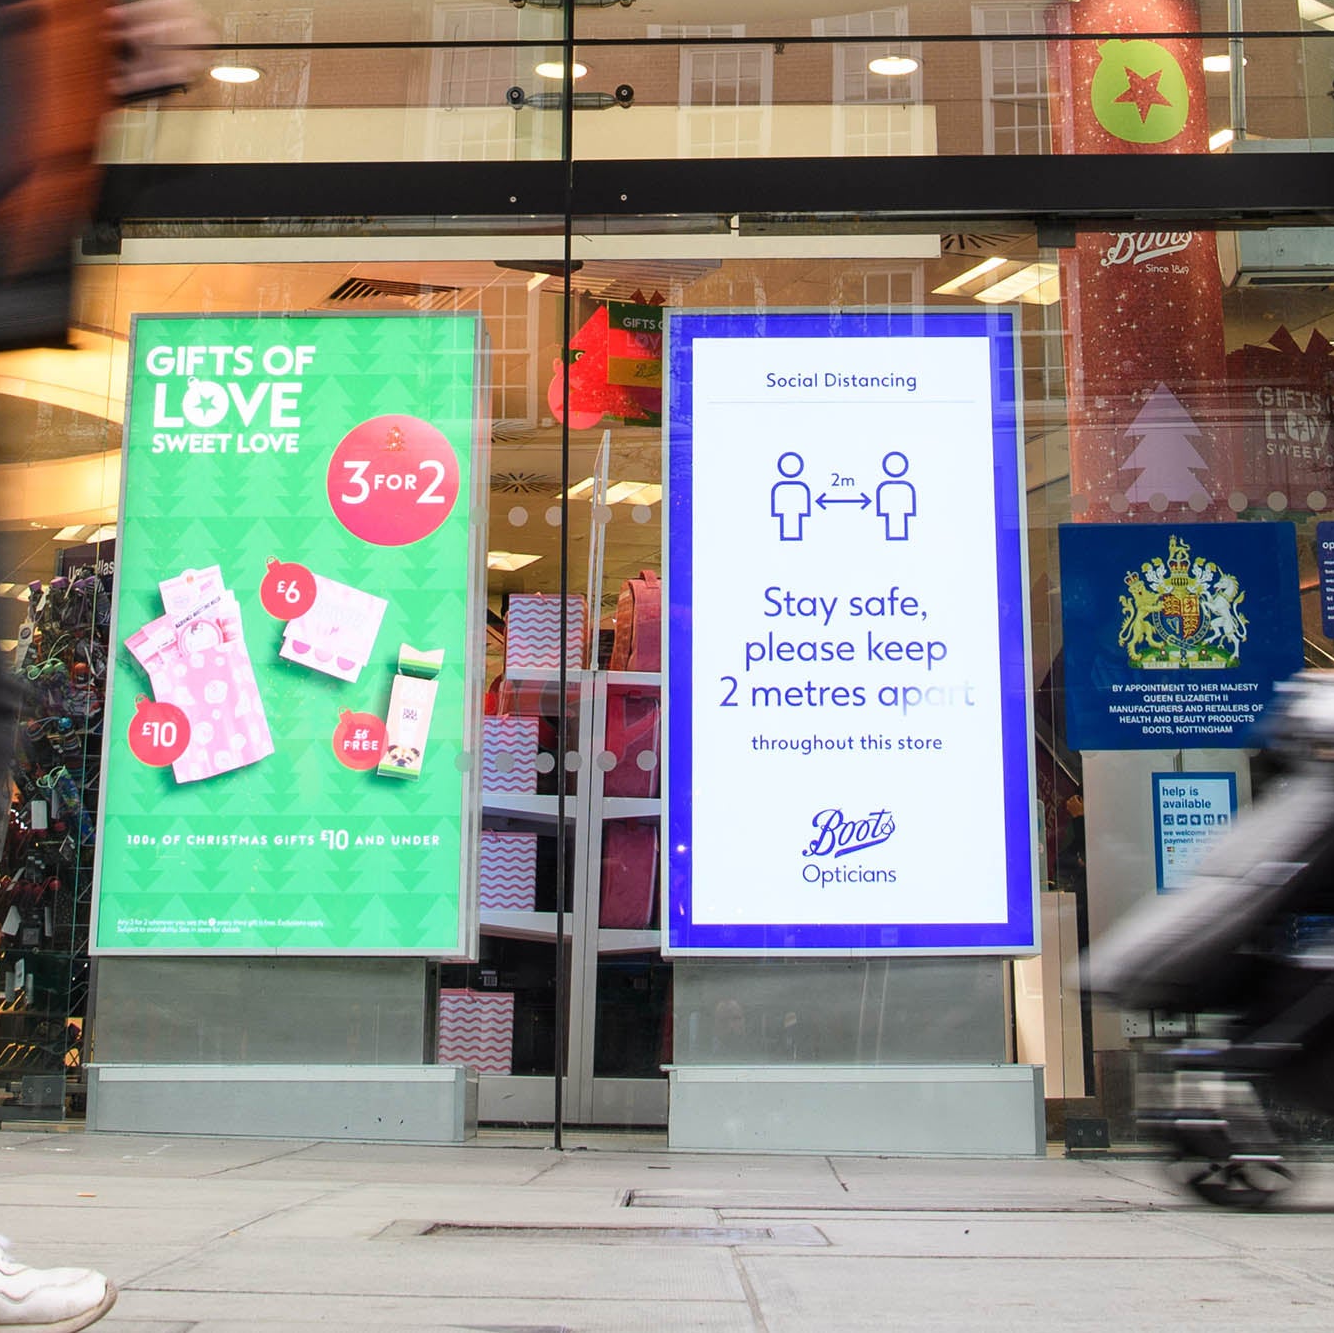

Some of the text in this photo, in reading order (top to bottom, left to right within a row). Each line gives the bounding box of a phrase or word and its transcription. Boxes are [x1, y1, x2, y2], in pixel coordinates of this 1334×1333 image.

[1145, 264, 1189, 275] Since 1849
[623, 317, 653, 329] GIFTS
[627, 332, 661, 349] LOV
[146, 346, 316, 376] GIFTS OF
[766, 372, 917, 392] Social Distancing
[152, 376, 303, 428] LOVE
[1256, 386, 1321, 414] GIFTS
[152, 434, 299, 454] SWEET LOVE
[341, 460, 445, 505] 3 FOR 2
[831, 473, 855, 487] 2m
[277, 580, 301, 603] £6
[764, 586, 928, 626] Stay safe,
[745, 631, 948, 671] please keep
[719, 676, 739, 707] 2
[752, 681, 866, 707] metres
[1112, 684, 1123, 692] BY
[1125, 684, 1185, 692] APPOINTMENT
[1175, 694, 1221, 702] ELIZABETH
[1109, 705, 1183, 713] MANUFACTURERS
[1205, 704, 1249, 712] RETAILERS
[1154, 715, 1172, 723] AND
[1173, 715, 1207, 723] BEAUTY
[1208, 715, 1255, 723] PRODUCTS
[142, 722, 177, 747] £10
[1142, 725, 1233, 734] BOOTS, NOTTINGHAM
[344, 740, 379, 750] FREE
[752, 735, 943, 755] throughout this store
[1163, 787, 1198, 797] help is
[1163, 799, 1211, 809] available
[126, 829, 441, 850] 100s OF CHRISTMAS GIFTS £10 AND UNDER
[802, 808, 896, 859] Boots
[802, 864, 897, 888] Opticians
